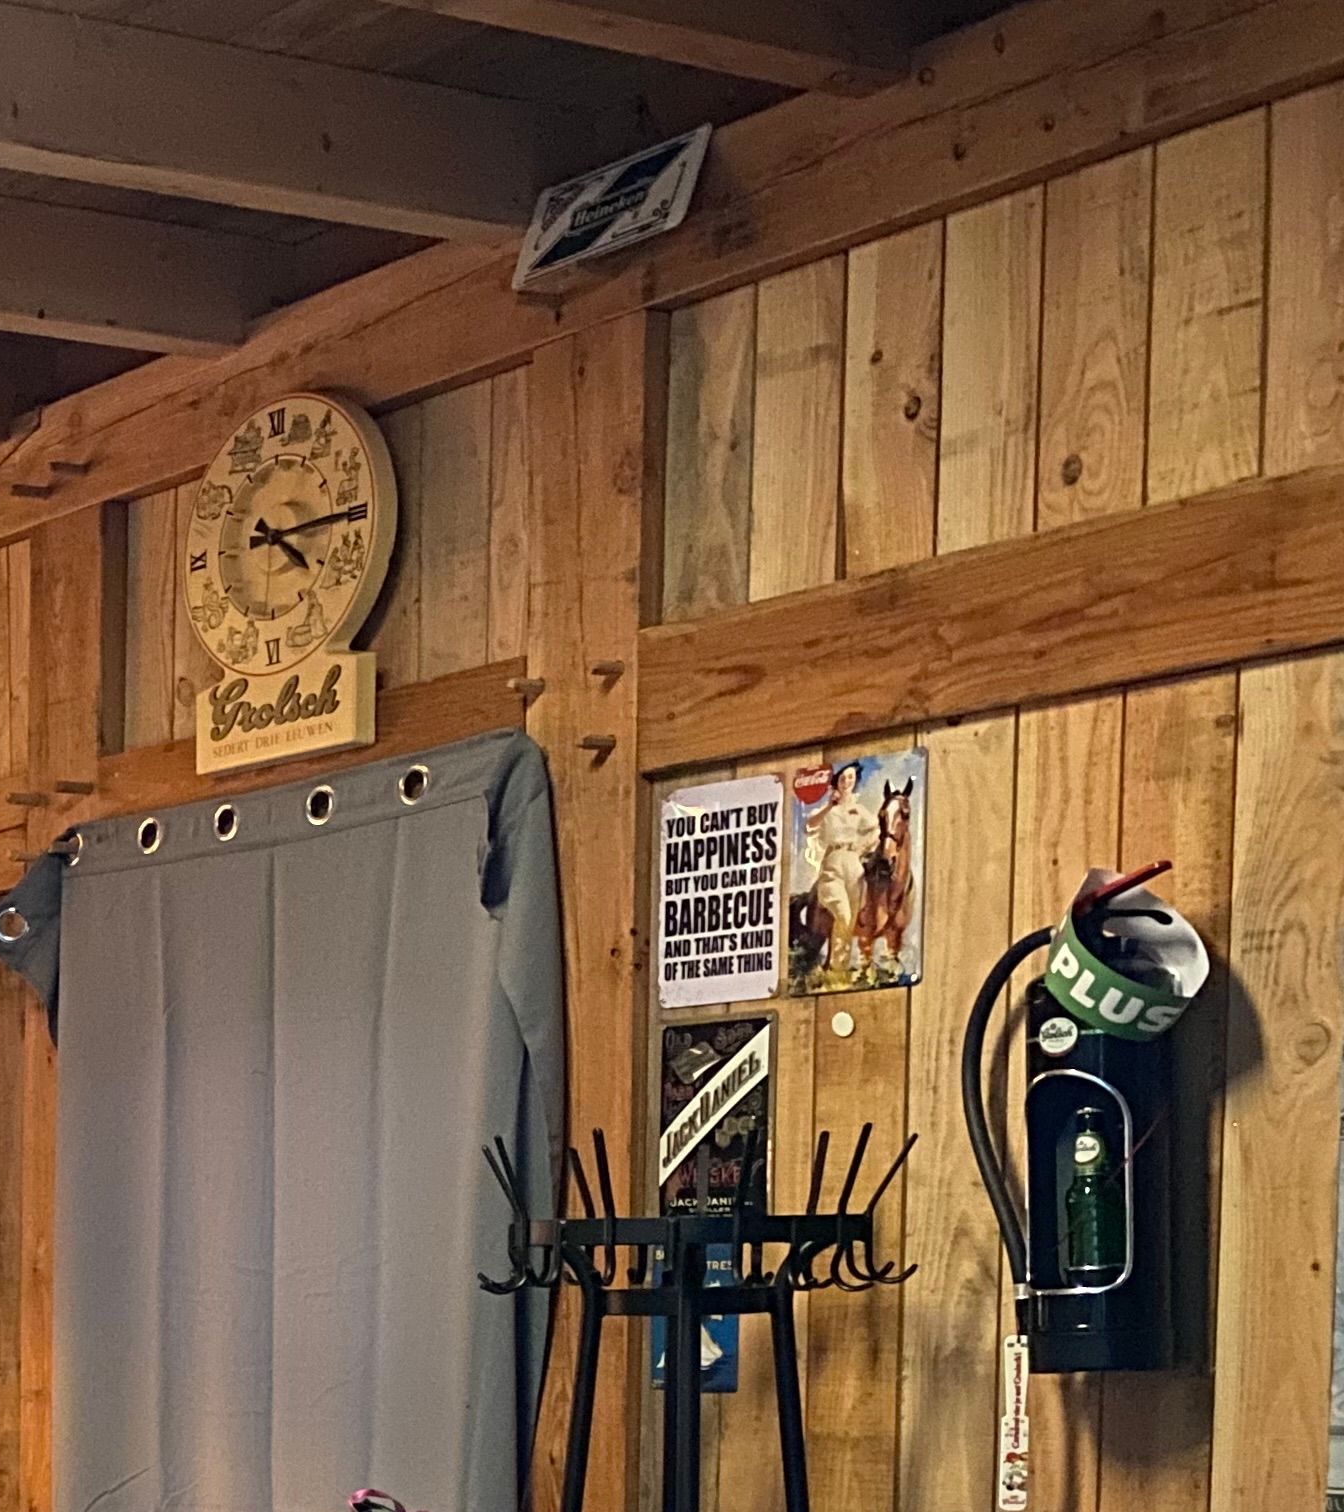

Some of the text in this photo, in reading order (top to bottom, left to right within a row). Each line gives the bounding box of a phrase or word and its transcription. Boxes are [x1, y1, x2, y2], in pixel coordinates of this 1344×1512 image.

[208, 664, 342, 741] Grolsch
[666, 801, 779, 839] YOU CAN'T BUY
[665, 826, 777, 875] HAPPINESS
[665, 864, 776, 896] BUT YOU CAN BUY
[664, 887, 774, 938] BARBECUE
[664, 929, 773, 959] AND THAT'S KIND
[664, 951, 772, 981] OF THE SAME THING
[1050, 942, 1185, 1034] PLUS
